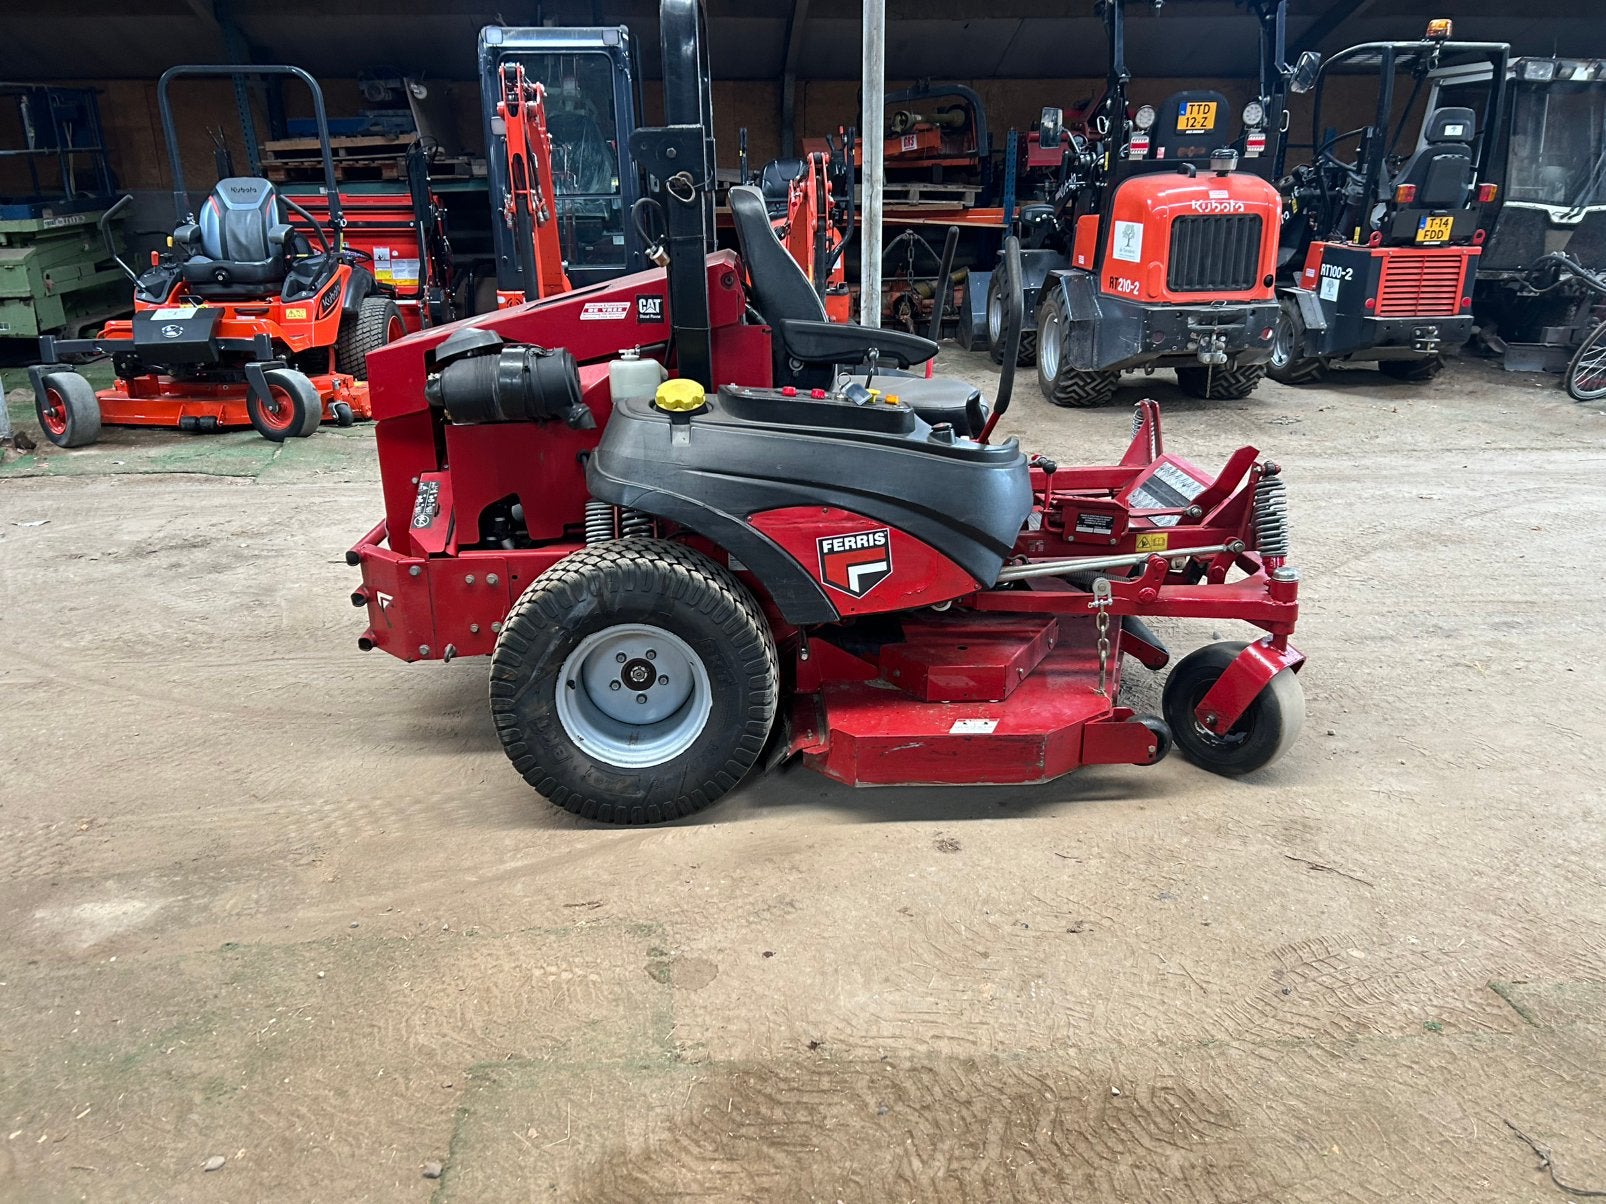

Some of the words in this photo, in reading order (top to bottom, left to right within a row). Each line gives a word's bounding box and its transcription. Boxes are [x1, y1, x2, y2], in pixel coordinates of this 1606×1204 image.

[1189, 104, 1211, 115] TTD
[1185, 117, 1208, 128] 12-Z
[1191, 199, 1245, 213] Kubota
[1429, 218, 1449, 228] T-14
[1423, 229, 1444, 240] FDD
[1320, 263, 1354, 281] RT100-2
[1109, 276, 1140, 295] RT210-2
[638, 298, 661, 314] CAT
[822, 532, 886, 553] FERRIS
